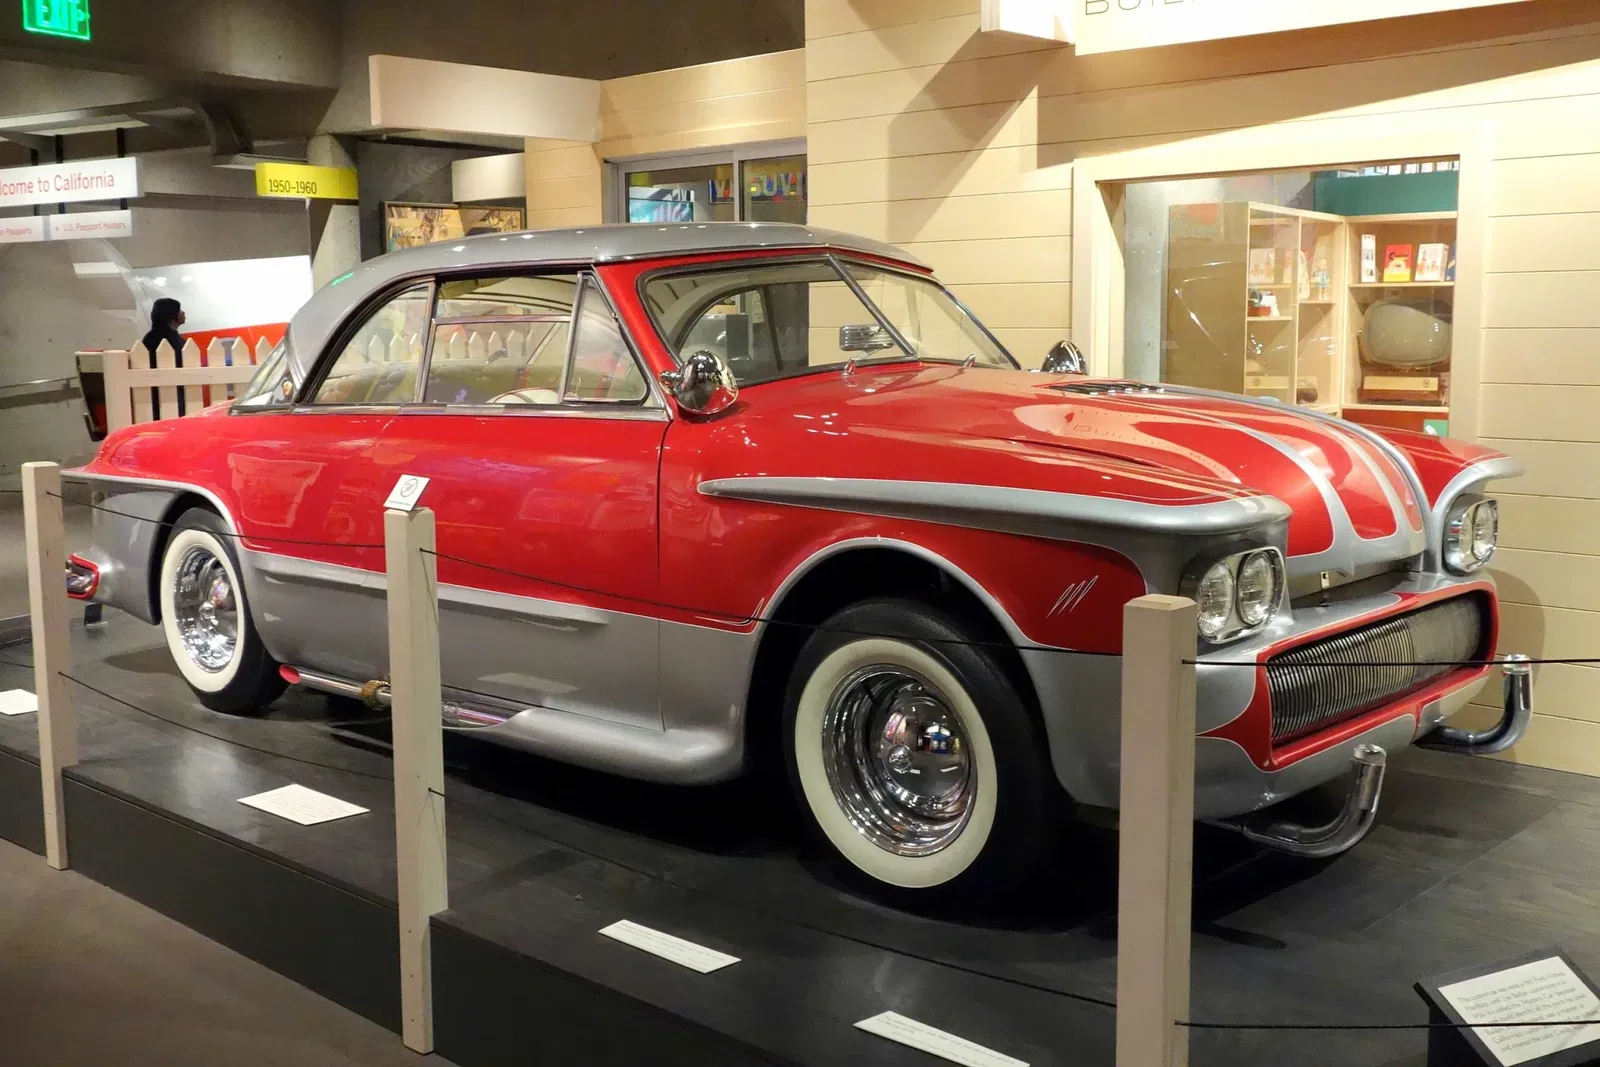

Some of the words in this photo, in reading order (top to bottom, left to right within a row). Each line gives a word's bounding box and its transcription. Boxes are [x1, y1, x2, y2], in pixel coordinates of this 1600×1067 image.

[38, 177, 50, 192] to
[54, 171, 115, 192] California
[268, 179, 317, 195] 1950-1960
[63, 224, 75, 232] U.S.
[76, 222, 102, 232] Passport
[103, 221, 127, 230] Holders
